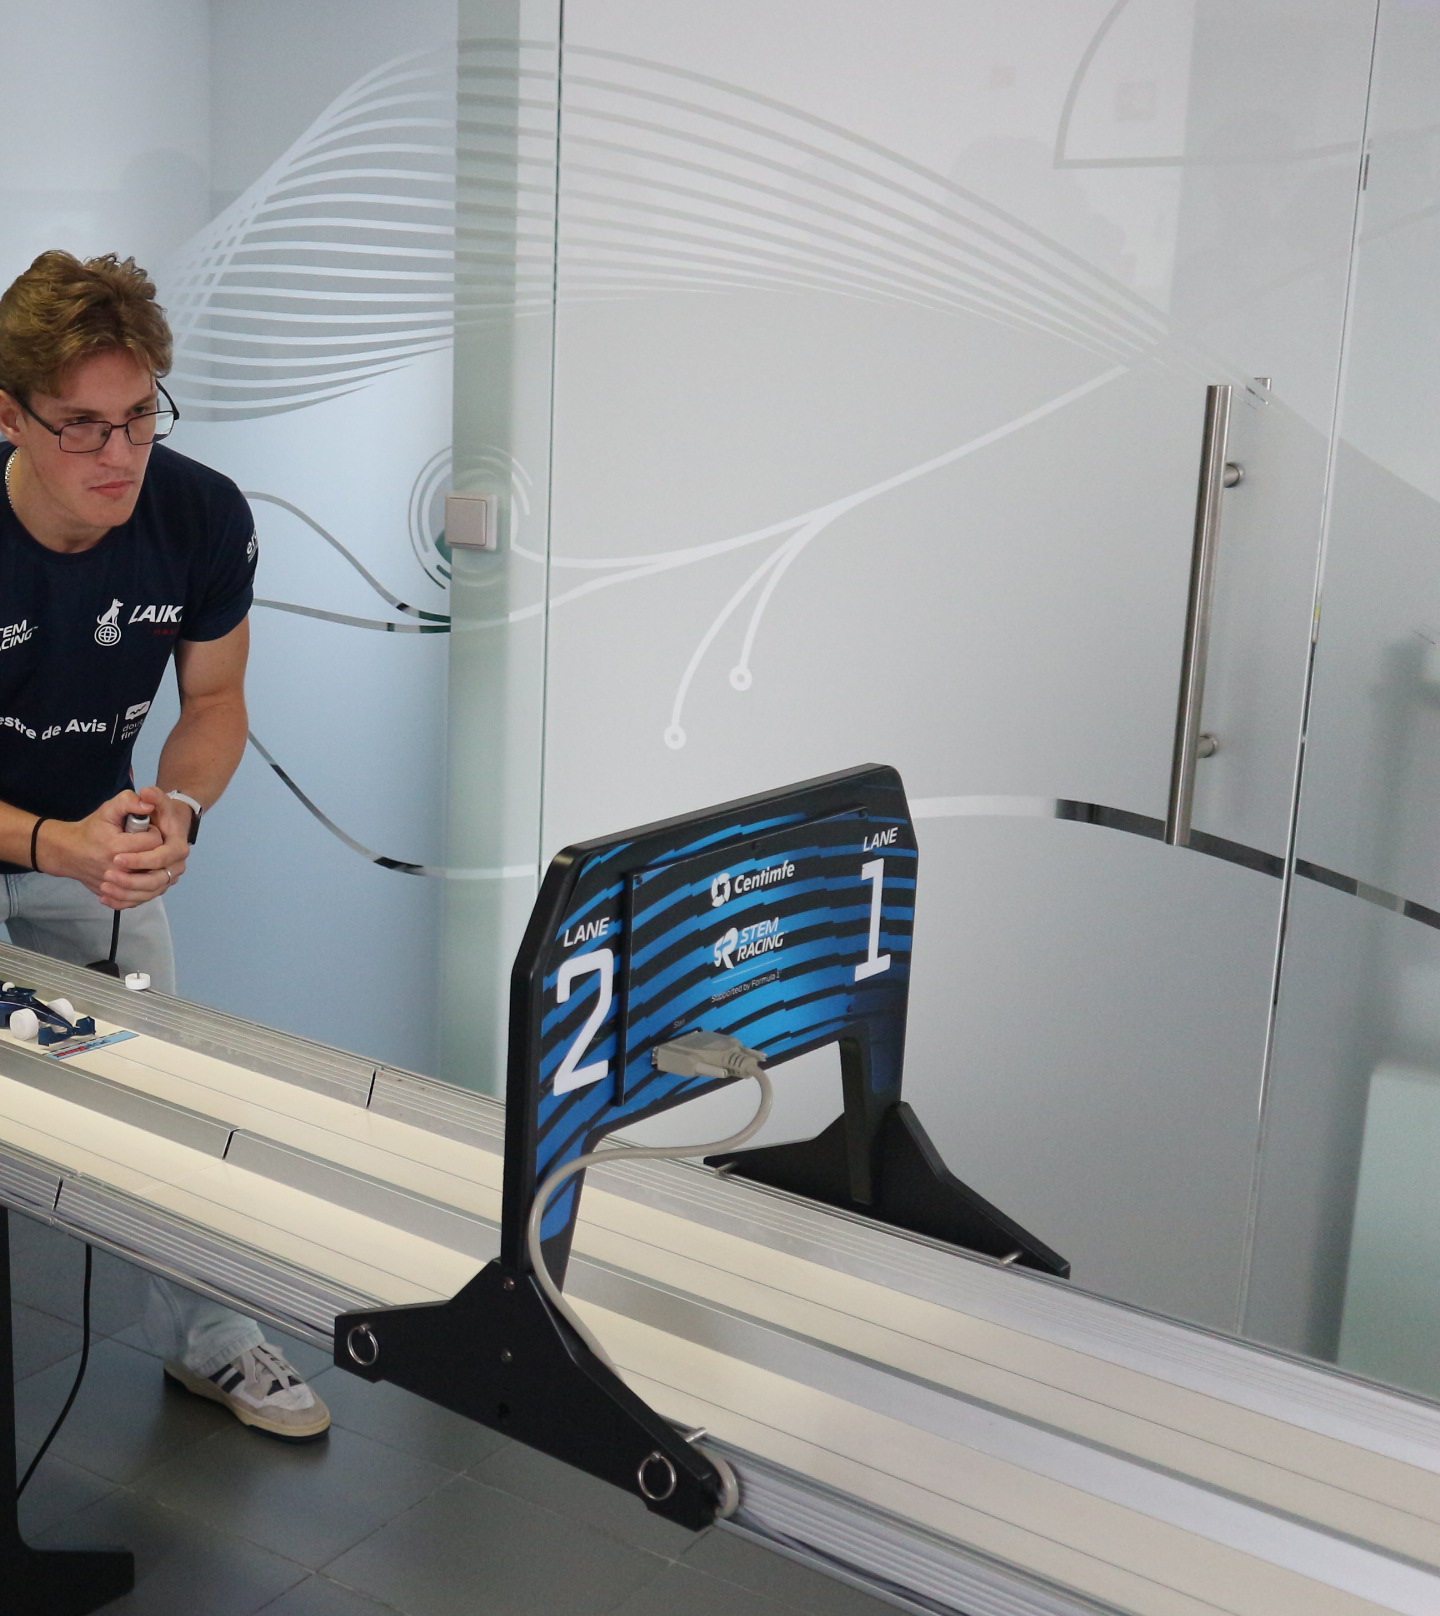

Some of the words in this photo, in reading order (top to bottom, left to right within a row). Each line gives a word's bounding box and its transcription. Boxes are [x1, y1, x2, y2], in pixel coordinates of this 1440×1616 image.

[128, 604, 184, 625] LAIK
[41, 725, 61, 740] de
[65, 718, 107, 733] Avis
[863, 827, 898, 852] LANE
[734, 860, 795, 894] Centimfe
[563, 917, 610, 948] LANE
[740, 917, 780, 944] STEM
[854, 858, 891, 982] 1
[736, 931, 785, 962] RACING
[711, 985, 742, 1003] Supported
[743, 982, 751, 992] by
[751, 973, 776, 988] Formula
[553, 948, 614, 1097] 2
